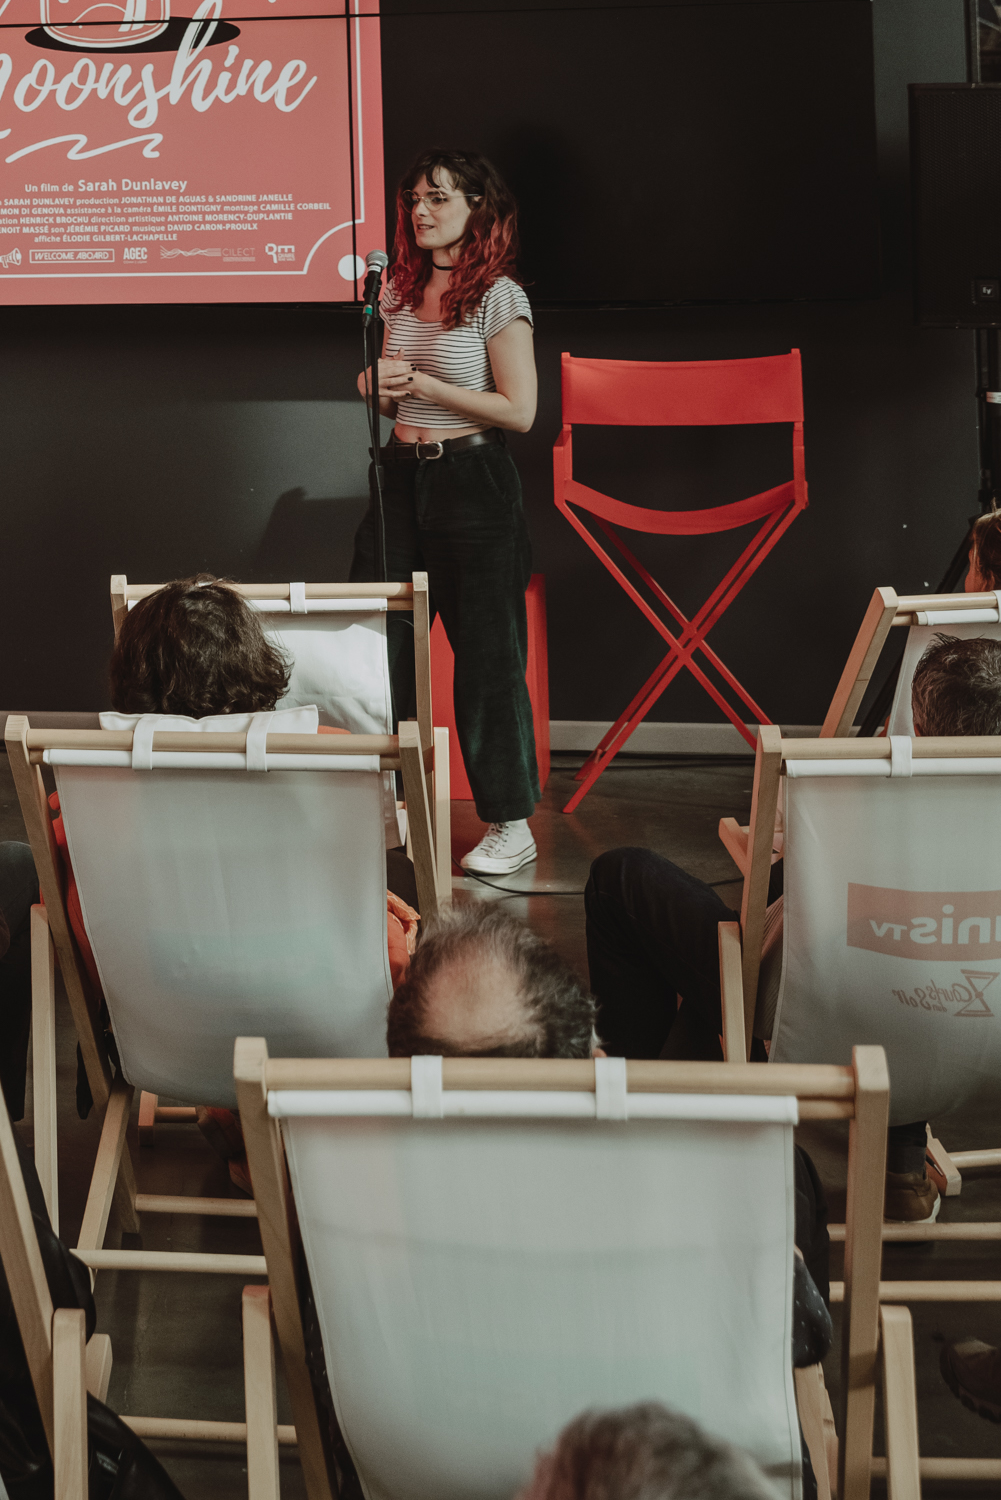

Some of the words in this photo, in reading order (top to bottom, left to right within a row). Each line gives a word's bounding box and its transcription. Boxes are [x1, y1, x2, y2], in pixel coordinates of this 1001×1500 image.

[25, 184, 38, 192] Un
[40, 184, 59, 192] film
[62, 183, 74, 191] de
[78, 179, 117, 191] Sarah
[122, 178, 187, 192] Dunlavey
[4, 198, 30, 206] SARAH
[77, 197, 119, 206] production
[121, 196, 163, 204] JONATHAN
[178, 195, 206, 203] AGUAS
[216, 194, 256, 202] SANDRINE
[32, 207, 64, 215] GENOVA
[67, 206, 105, 214] assistance
[114, 205, 121, 213] la
[123, 205, 151, 213] caméra
[153, 204, 176, 212] ÉMILE
[179, 204, 221, 212] DONTIGNY
[224, 205, 258, 214] montage
[260, 203, 295, 211] CAMILLE
[56, 216, 89, 224] BROCHU
[128, 215, 165, 224] artistique
[168, 214, 202, 222] ANTOINE
[205, 213, 293, 221] MORENCY-DUPLANTIE
[22, 225, 48, 233] MASSÉ
[66, 225, 98, 233] JÉRÉMIE
[133, 224, 165, 233] musique
[194, 223, 258, 231] CARON-PROULX
[63, 234, 90, 242] ÉLODIE
[93, 234, 178, 242] GILBERT-LACHAPELLE
[76, 252, 109, 260] ABOARD
[123, 248, 147, 260] AGEC
[222, 248, 255, 256] CILECT
